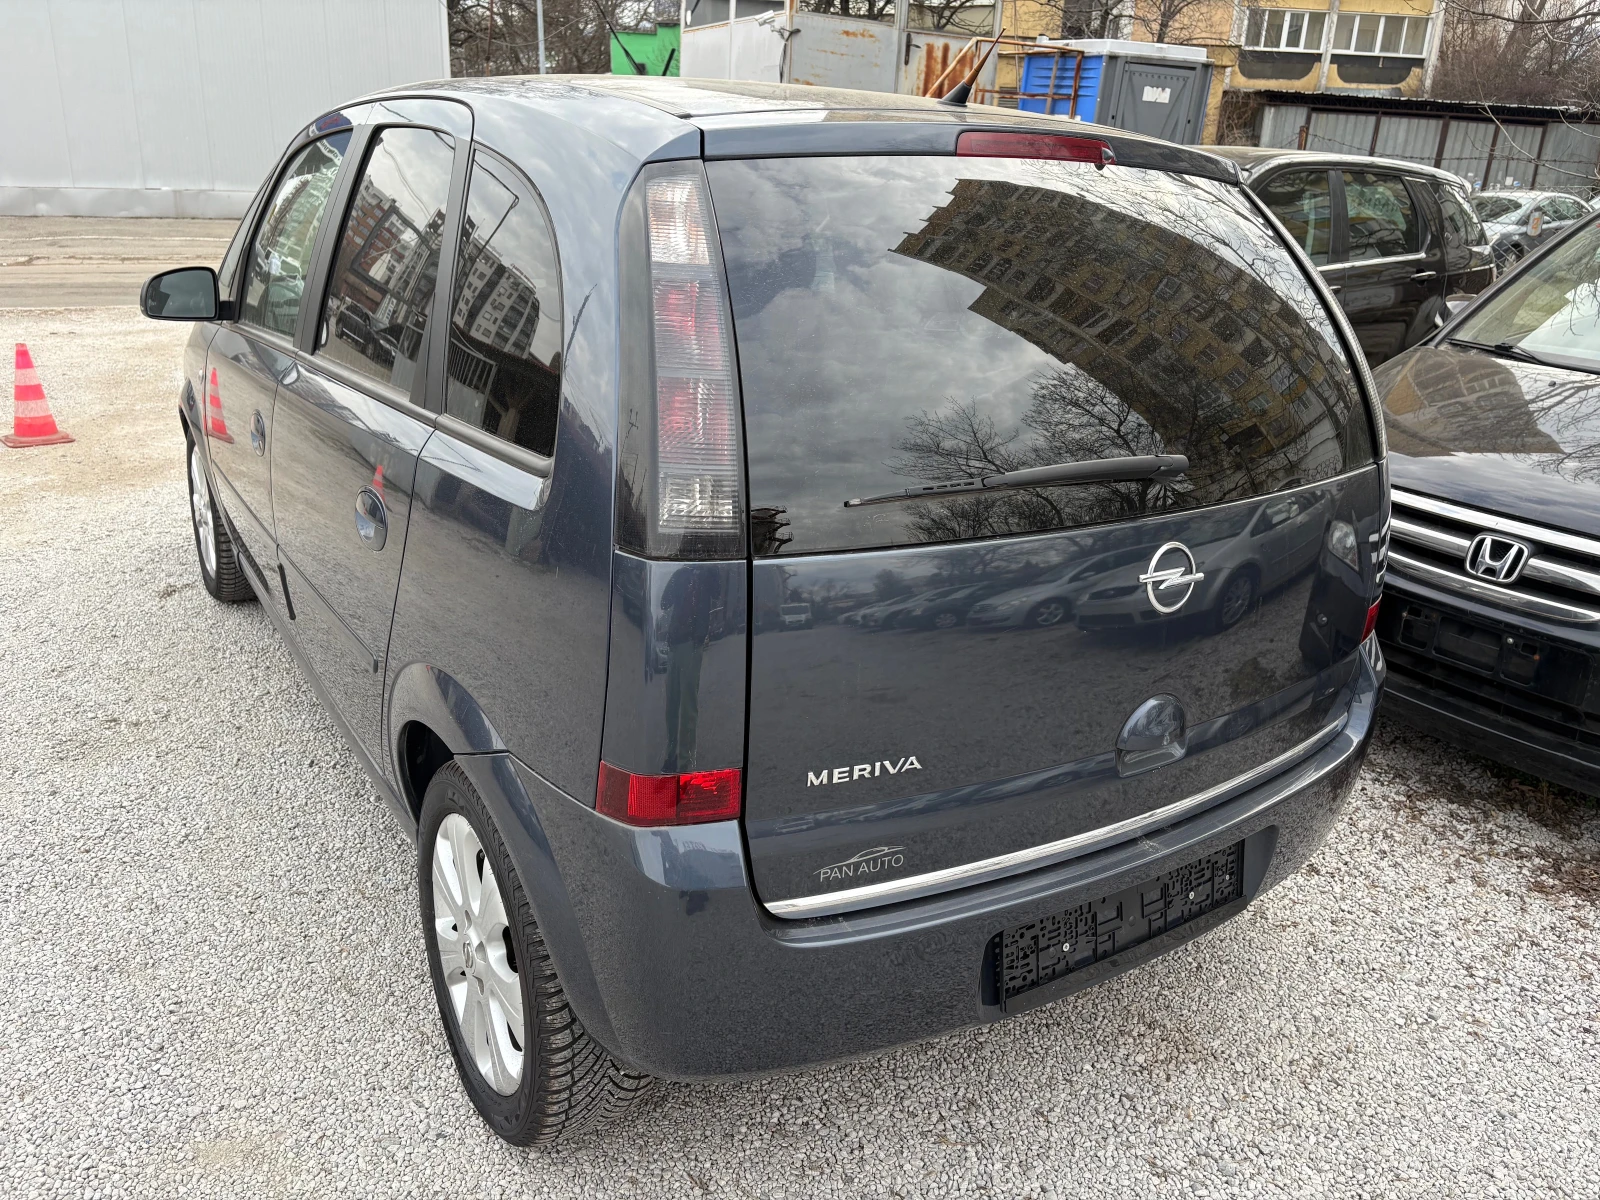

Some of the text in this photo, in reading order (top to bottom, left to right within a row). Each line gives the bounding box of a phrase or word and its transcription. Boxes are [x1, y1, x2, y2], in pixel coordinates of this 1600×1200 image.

[806, 756, 923, 787] MERIVA
[819, 854, 904, 883] PAN AUTO
